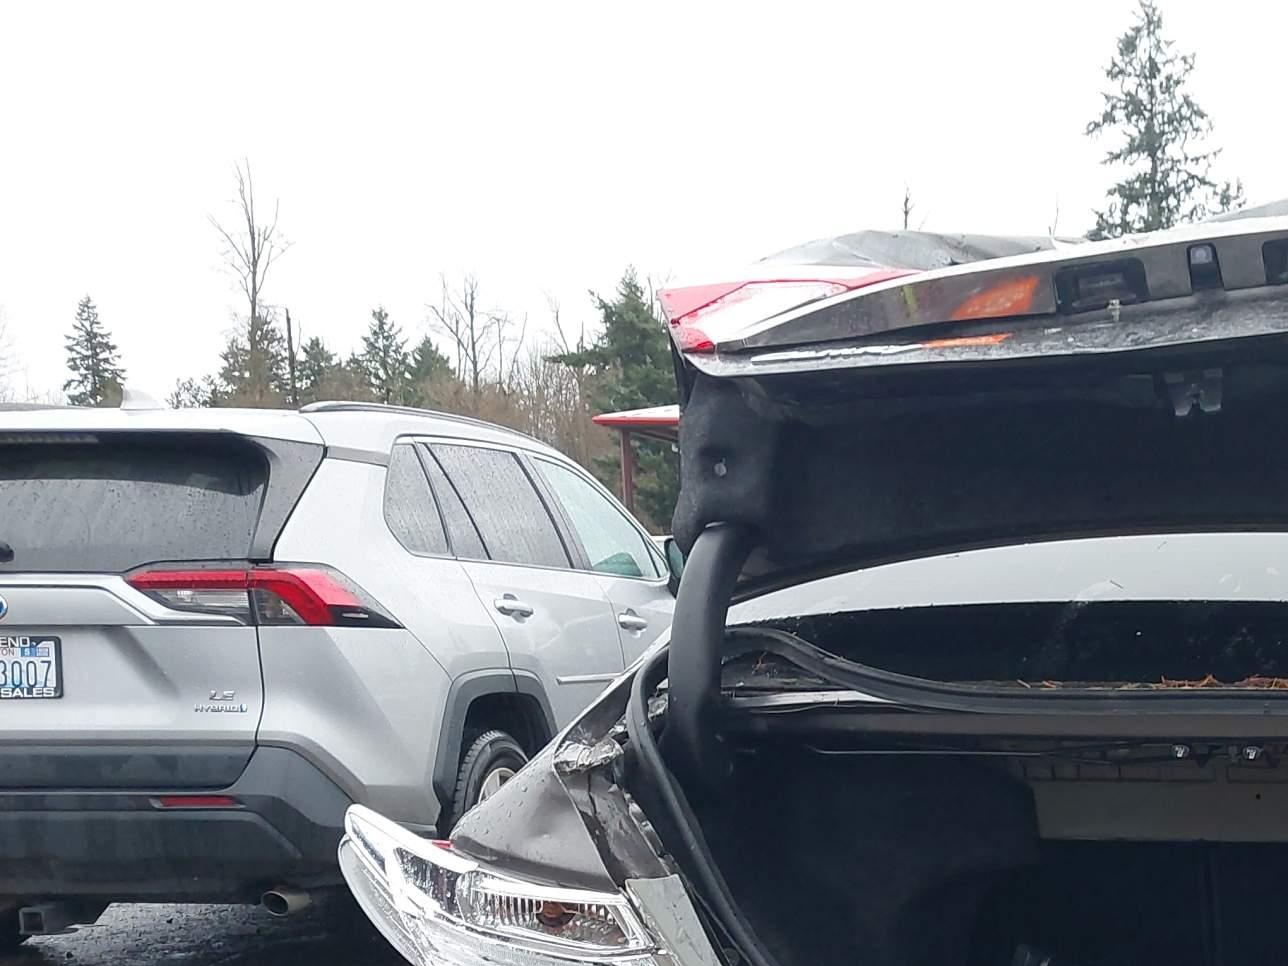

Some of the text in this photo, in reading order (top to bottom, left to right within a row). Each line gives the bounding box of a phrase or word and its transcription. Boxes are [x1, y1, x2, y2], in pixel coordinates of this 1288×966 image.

[0, 687, 55, 698] SALES
[209, 690, 235, 701] LE
[194, 703, 239, 713] HYBRID
